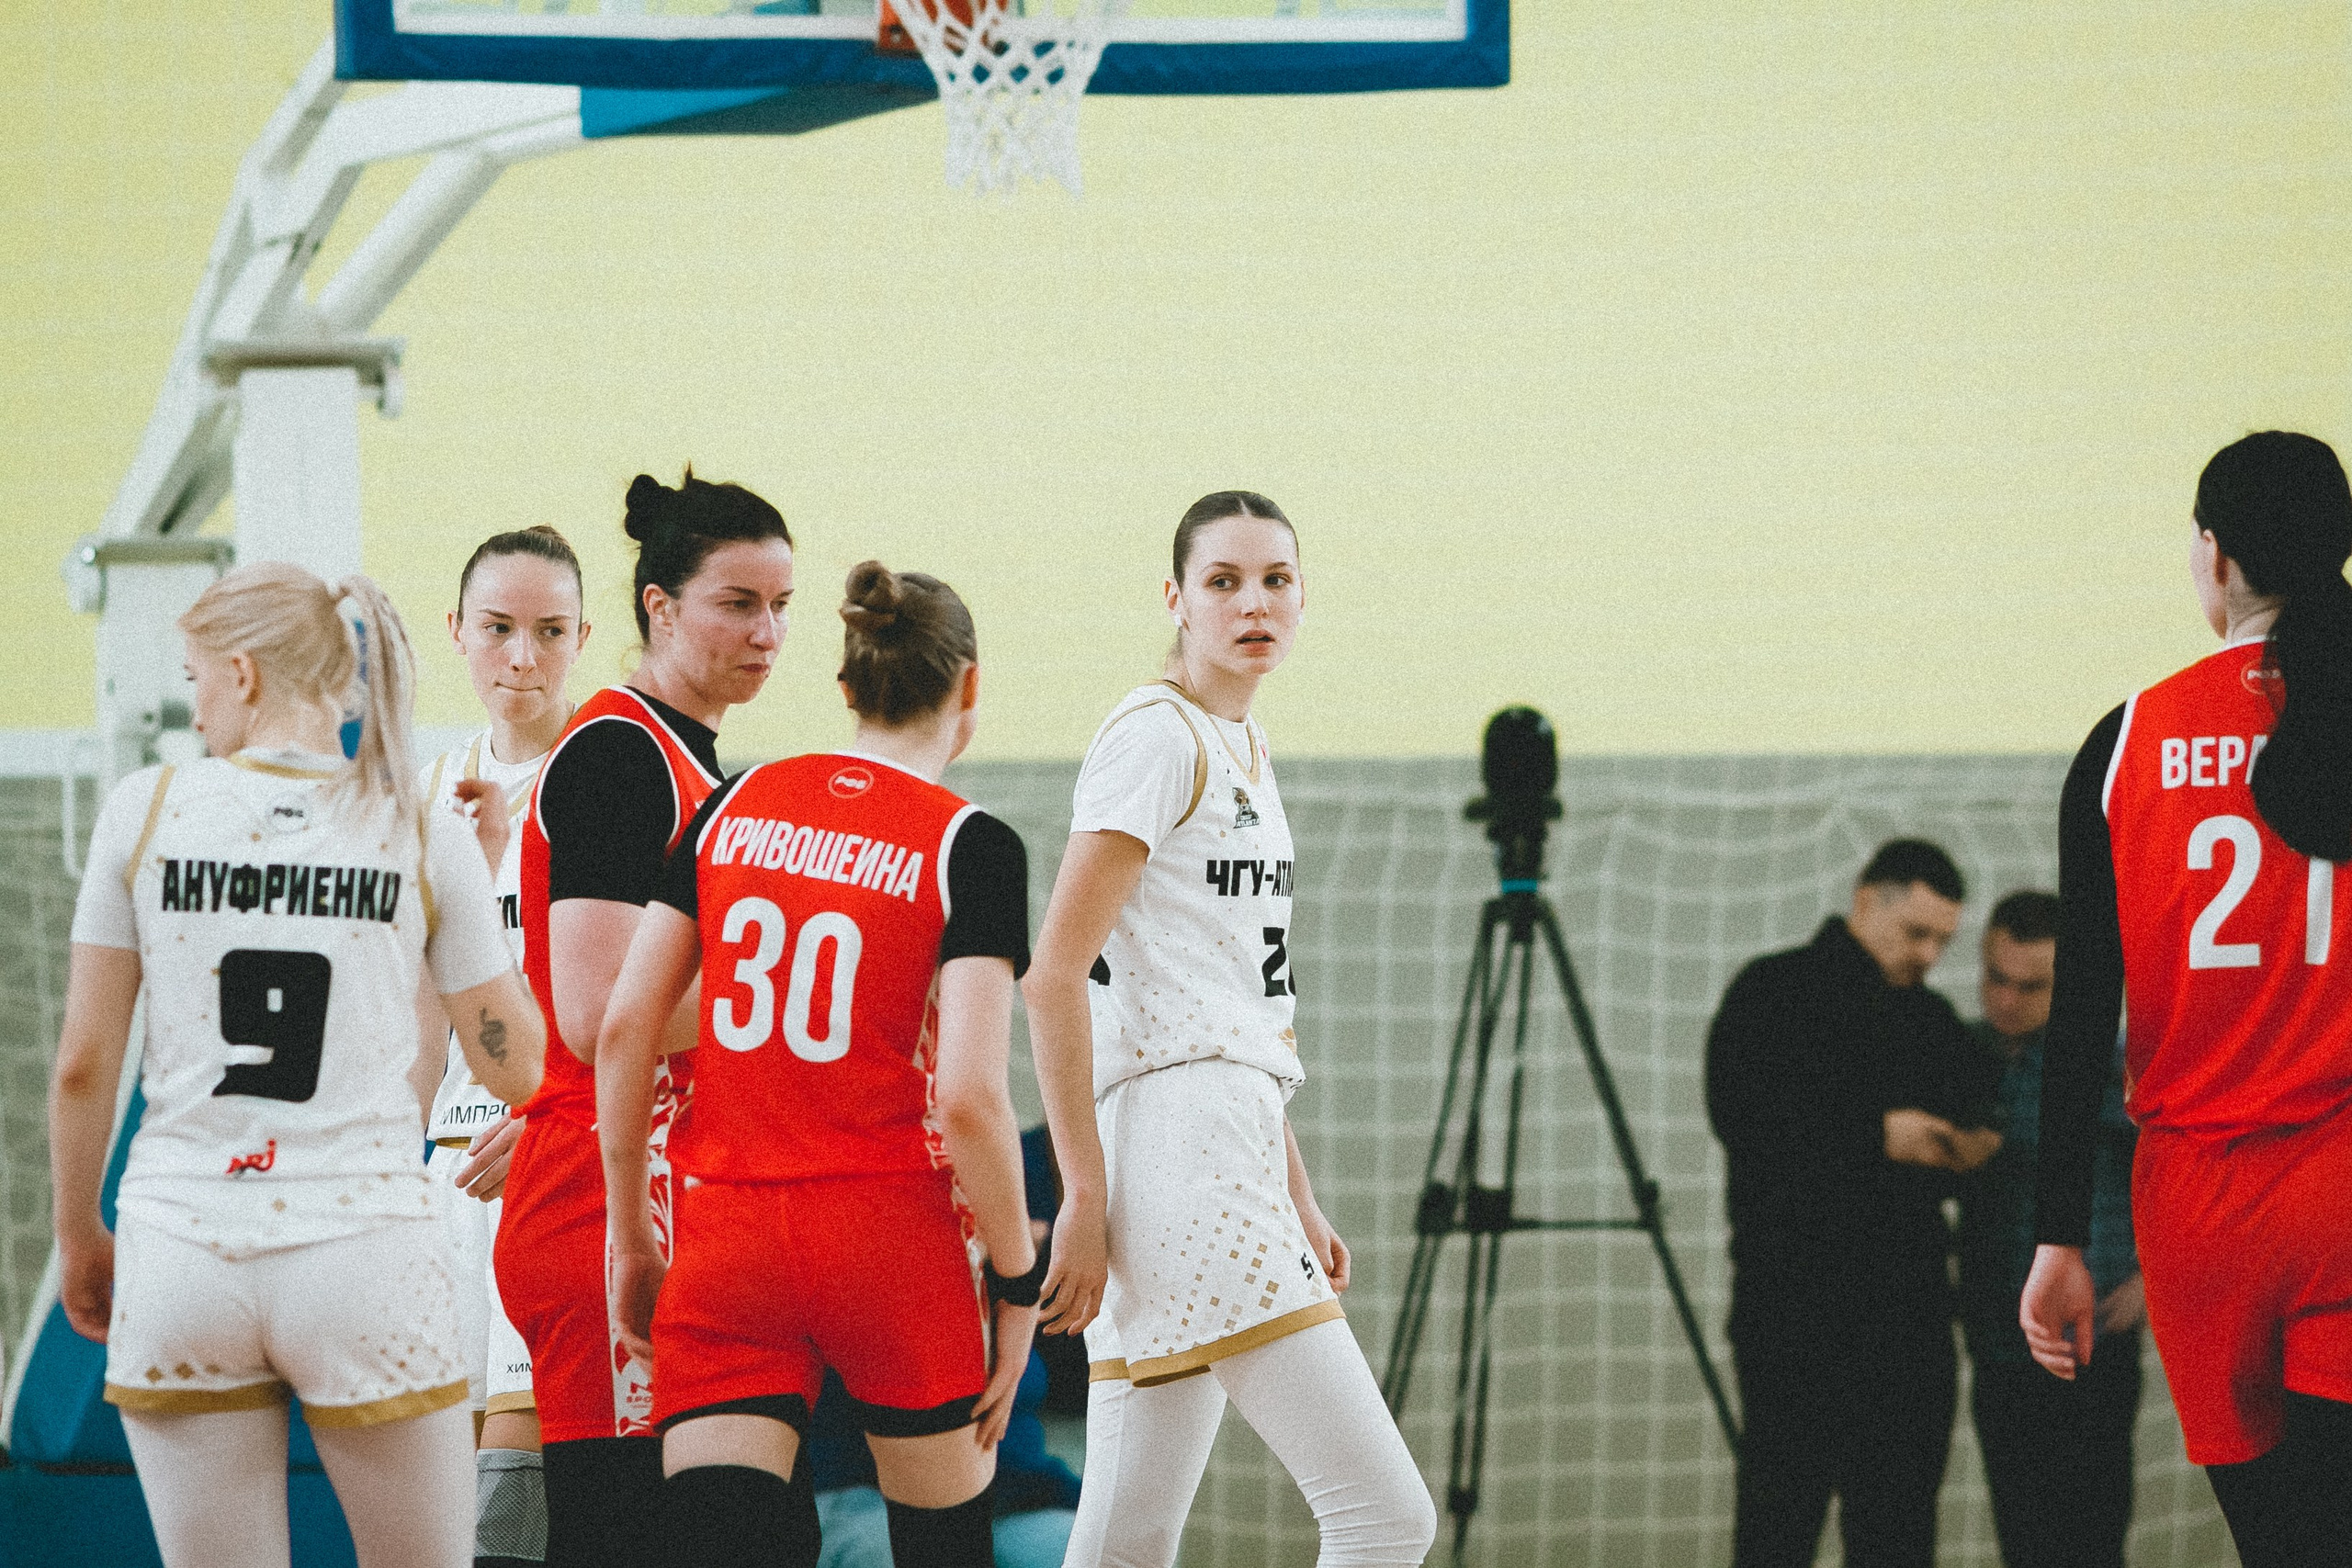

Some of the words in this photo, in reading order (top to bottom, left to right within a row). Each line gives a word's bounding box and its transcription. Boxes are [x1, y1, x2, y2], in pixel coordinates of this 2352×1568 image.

[163, 860, 401, 922] АНУФРИЕНКО
[711, 816, 924, 903] КРИВОШЕИНА
[1206, 860, 1295, 897] ЧГУ-АТЛ
[713, 897, 863, 1063] 30
[1261, 927, 1295, 997] 2
[211, 949, 332, 1103] 9
